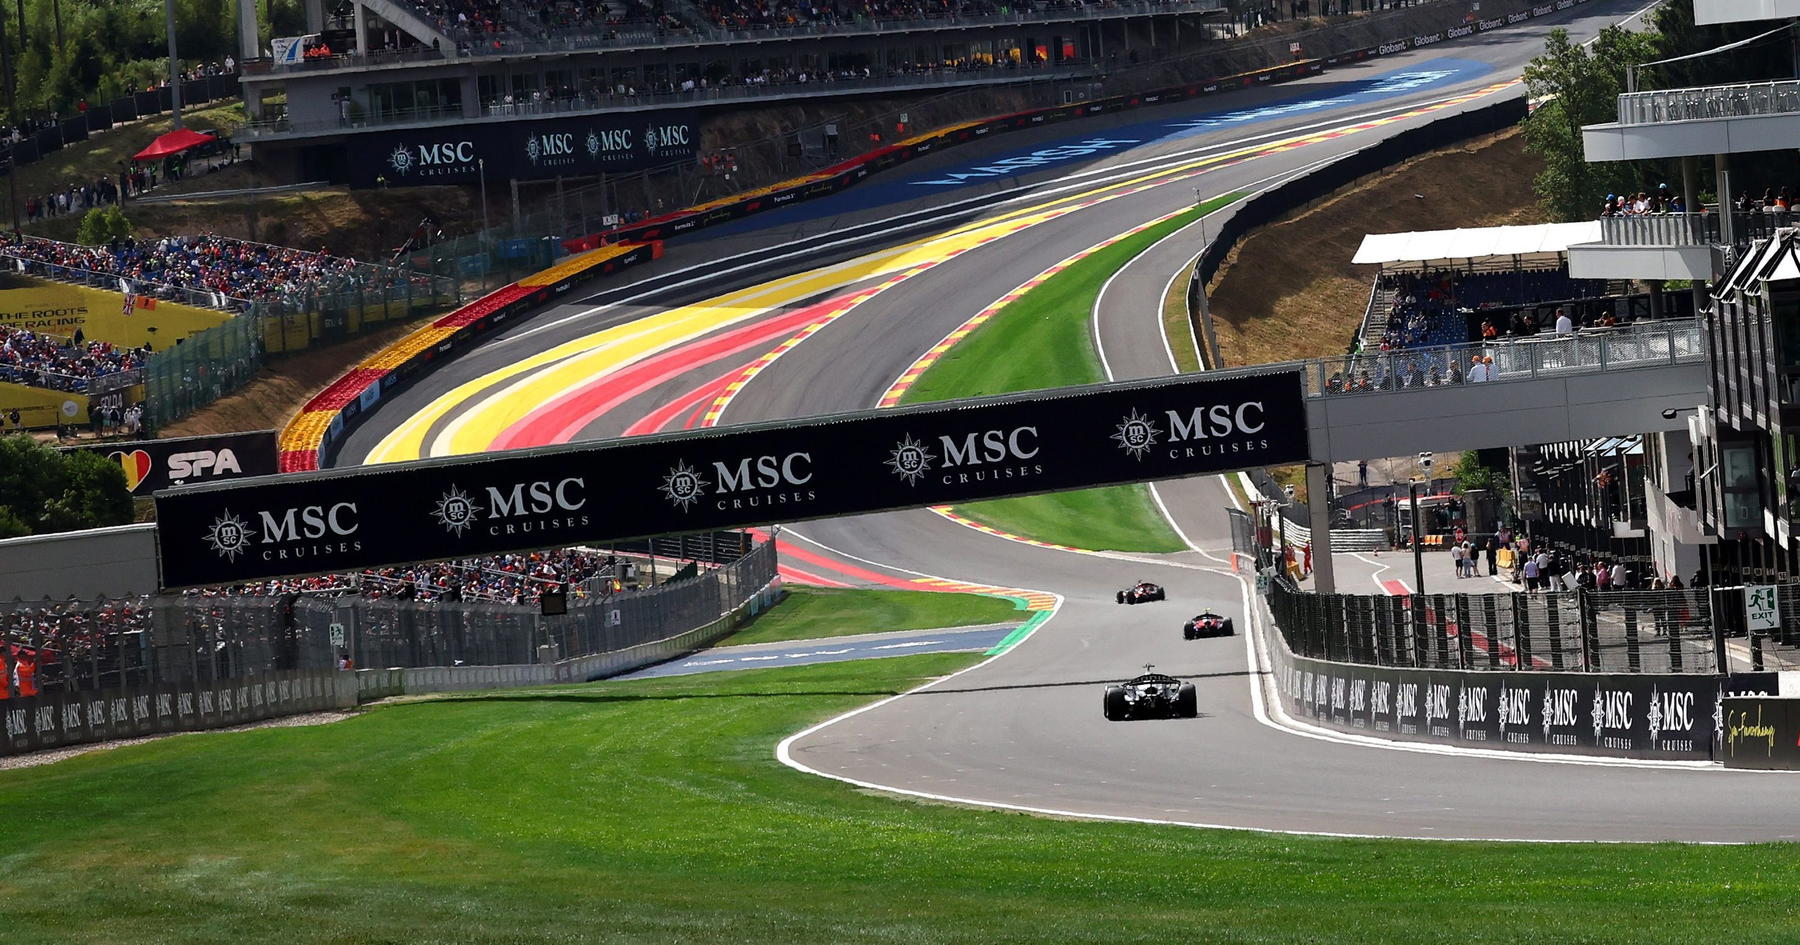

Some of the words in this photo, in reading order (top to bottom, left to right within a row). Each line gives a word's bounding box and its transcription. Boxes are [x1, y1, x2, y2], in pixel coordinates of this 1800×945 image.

[1414, 33, 1441, 47] Globant
[1447, 25, 1473, 38] Globant
[1379, 40, 1407, 55] Globant
[542, 133, 574, 155] MSC
[600, 129, 632, 151] MSC
[657, 125, 690, 146] MSC
[417, 142, 474, 166] MSC
[419, 167, 475, 176] CRUISES
[25, 317, 85, 328] RACING
[32, 306, 88, 318] ROOTS
[1164, 402, 1265, 442] MSC
[938, 427, 1040, 468] MSC
[1169, 441, 1268, 459] CRUISES
[168, 448, 242, 480] SPA
[712, 453, 813, 494] MSC
[942, 466, 1042, 485] CRUISES
[485, 478, 586, 519] MSC
[717, 493, 816, 511] CRUISES
[257, 502, 360, 544] MSC
[489, 518, 590, 537] CRUISES
[262, 542, 362, 561] CRUISES
[1751, 611, 1774, 620] EXIT
[1377, 681, 1391, 714] MSC
[1402, 683, 1418, 717] MSC
[1432, 684, 1450, 720] MSC
[1467, 686, 1488, 723] MSC
[1508, 688, 1531, 725] MSC
[1553, 688, 1578, 726] MSC
[40, 705, 55, 731] MSC
[67, 702, 81, 729] MSC
[1604, 690, 1633, 730] MSC
[1662, 691, 1694, 731] MSC
[12, 708, 27, 735] MSC
[1465, 729, 1487, 741] CRUISES
[1507, 732, 1530, 744] CRUISES
[1552, 734, 1577, 746] CRUISES
[1604, 736, 1632, 750] CRUISES
[1662, 739, 1693, 752] CRUISES
